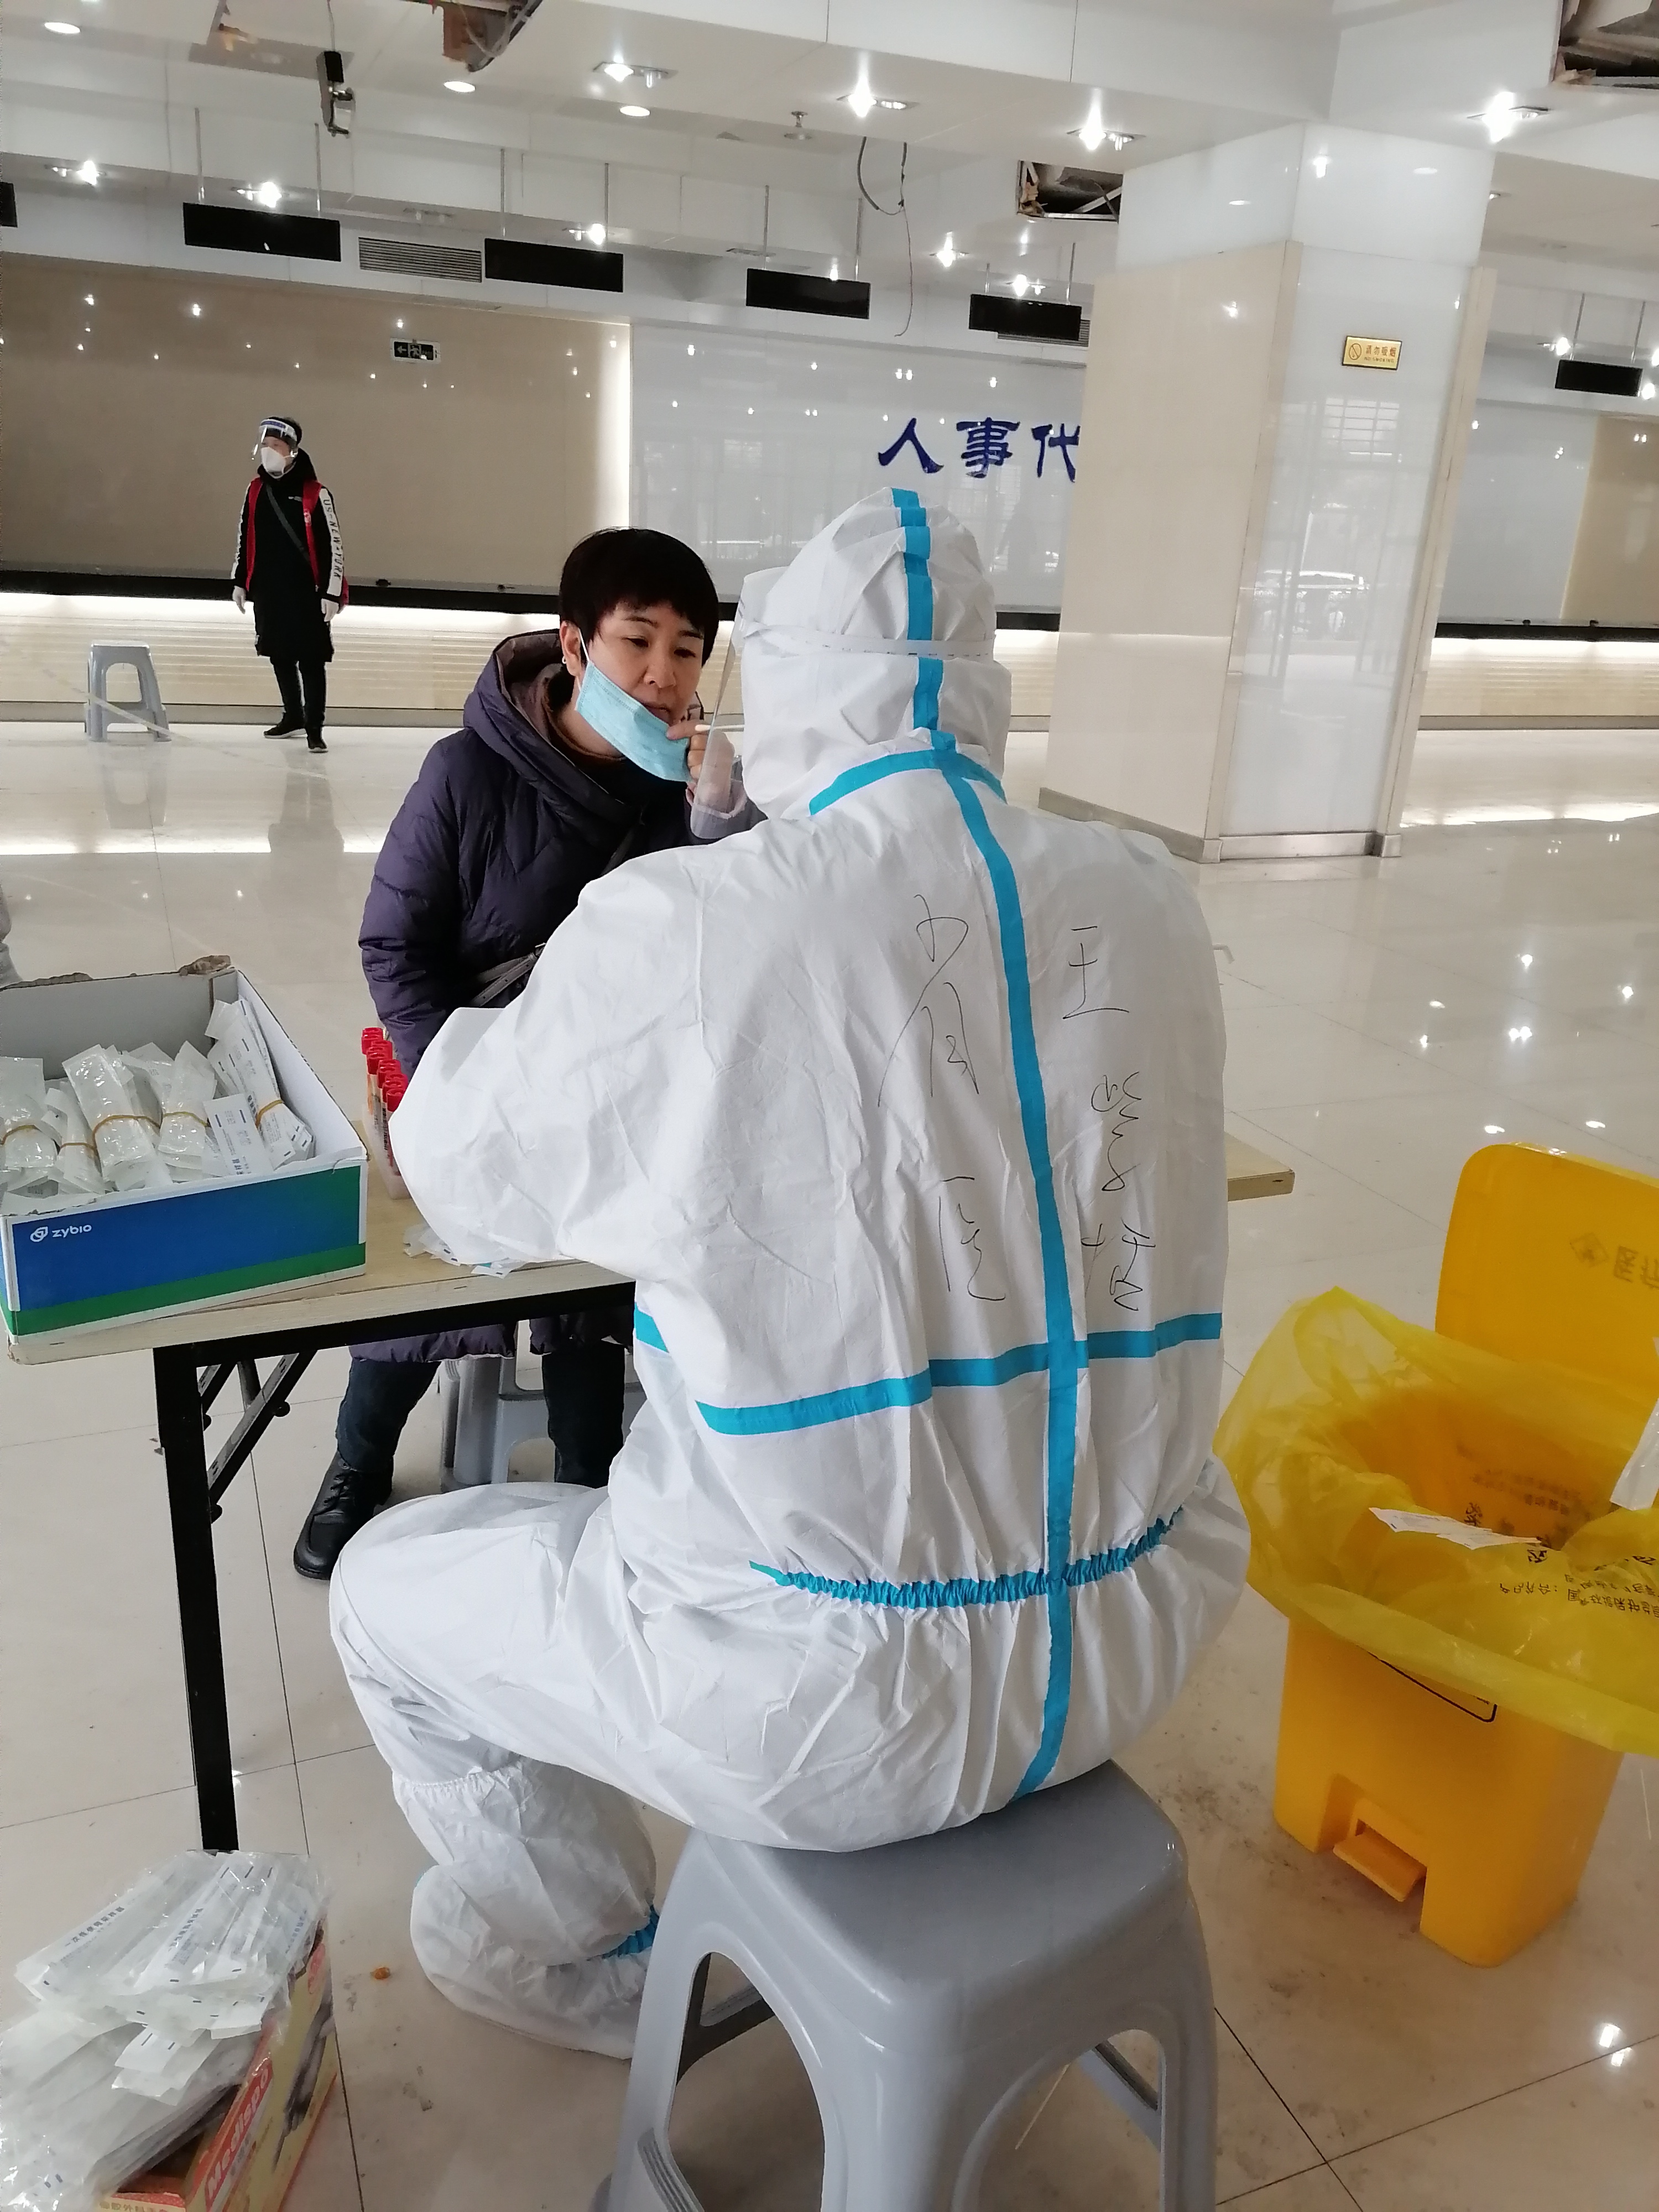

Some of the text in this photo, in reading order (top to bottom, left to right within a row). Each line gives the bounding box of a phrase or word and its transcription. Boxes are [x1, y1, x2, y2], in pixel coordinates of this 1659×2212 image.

[878, 417, 1081, 483] 人事代
[51, 1224, 92, 1239] zybio
